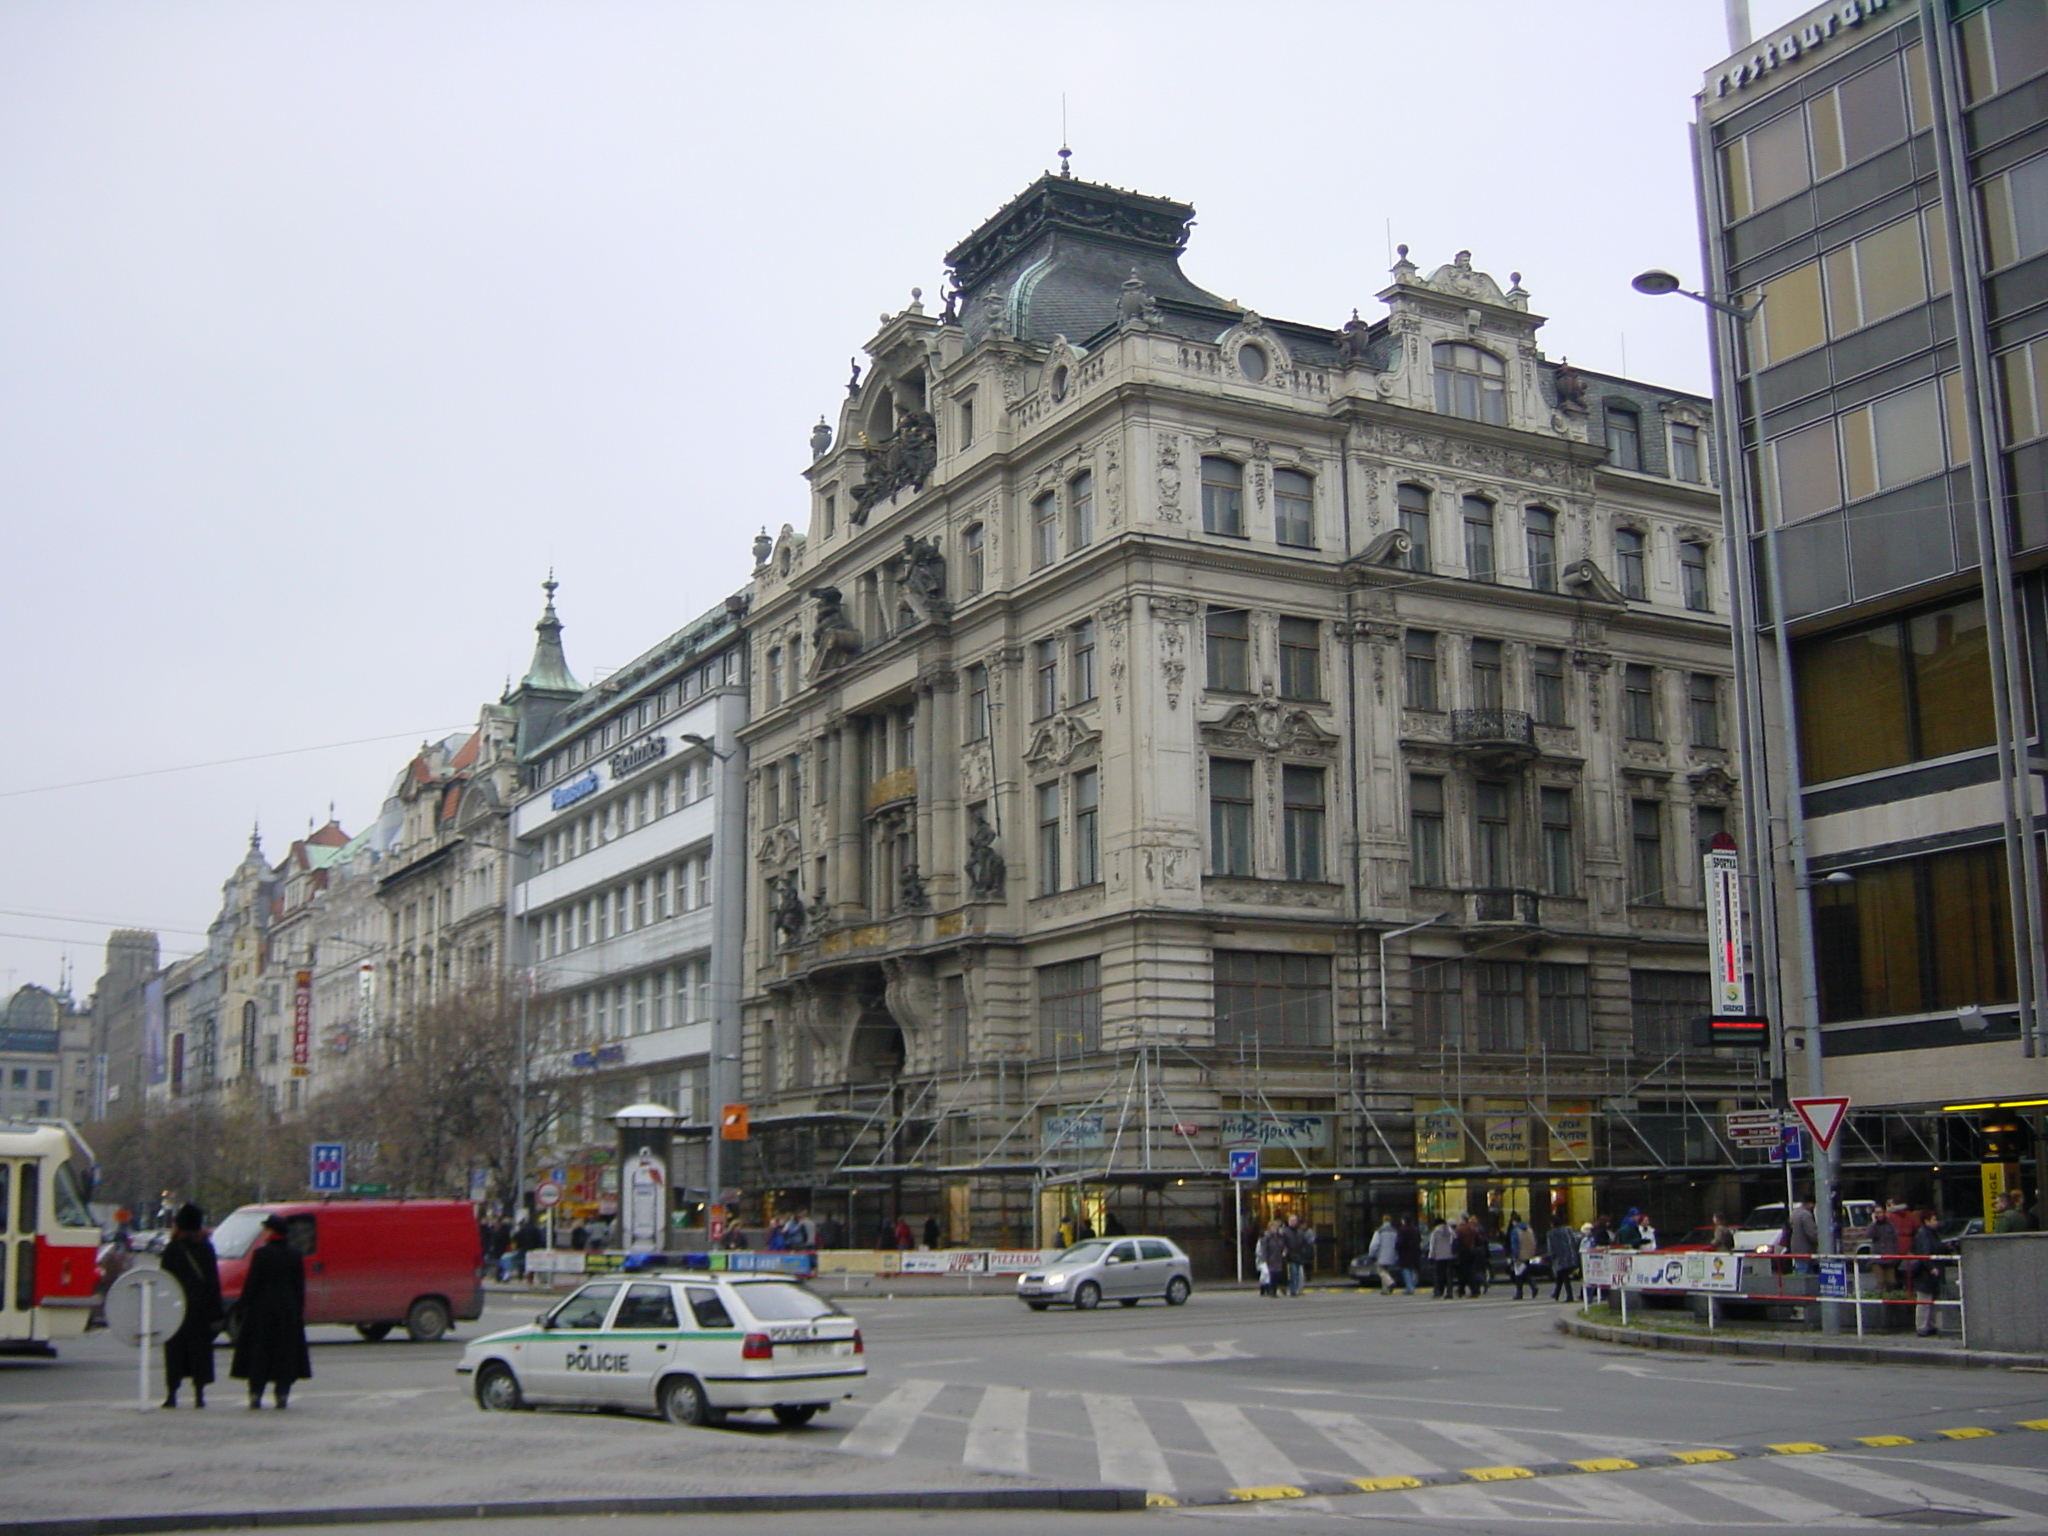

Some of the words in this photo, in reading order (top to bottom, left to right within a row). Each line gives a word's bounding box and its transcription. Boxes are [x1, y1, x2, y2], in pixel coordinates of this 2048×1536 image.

[1714, 0, 1887, 97] restauran
[991, 1254, 1042, 1264] PIZZERIA
[566, 1353, 630, 1373] POLICIE
